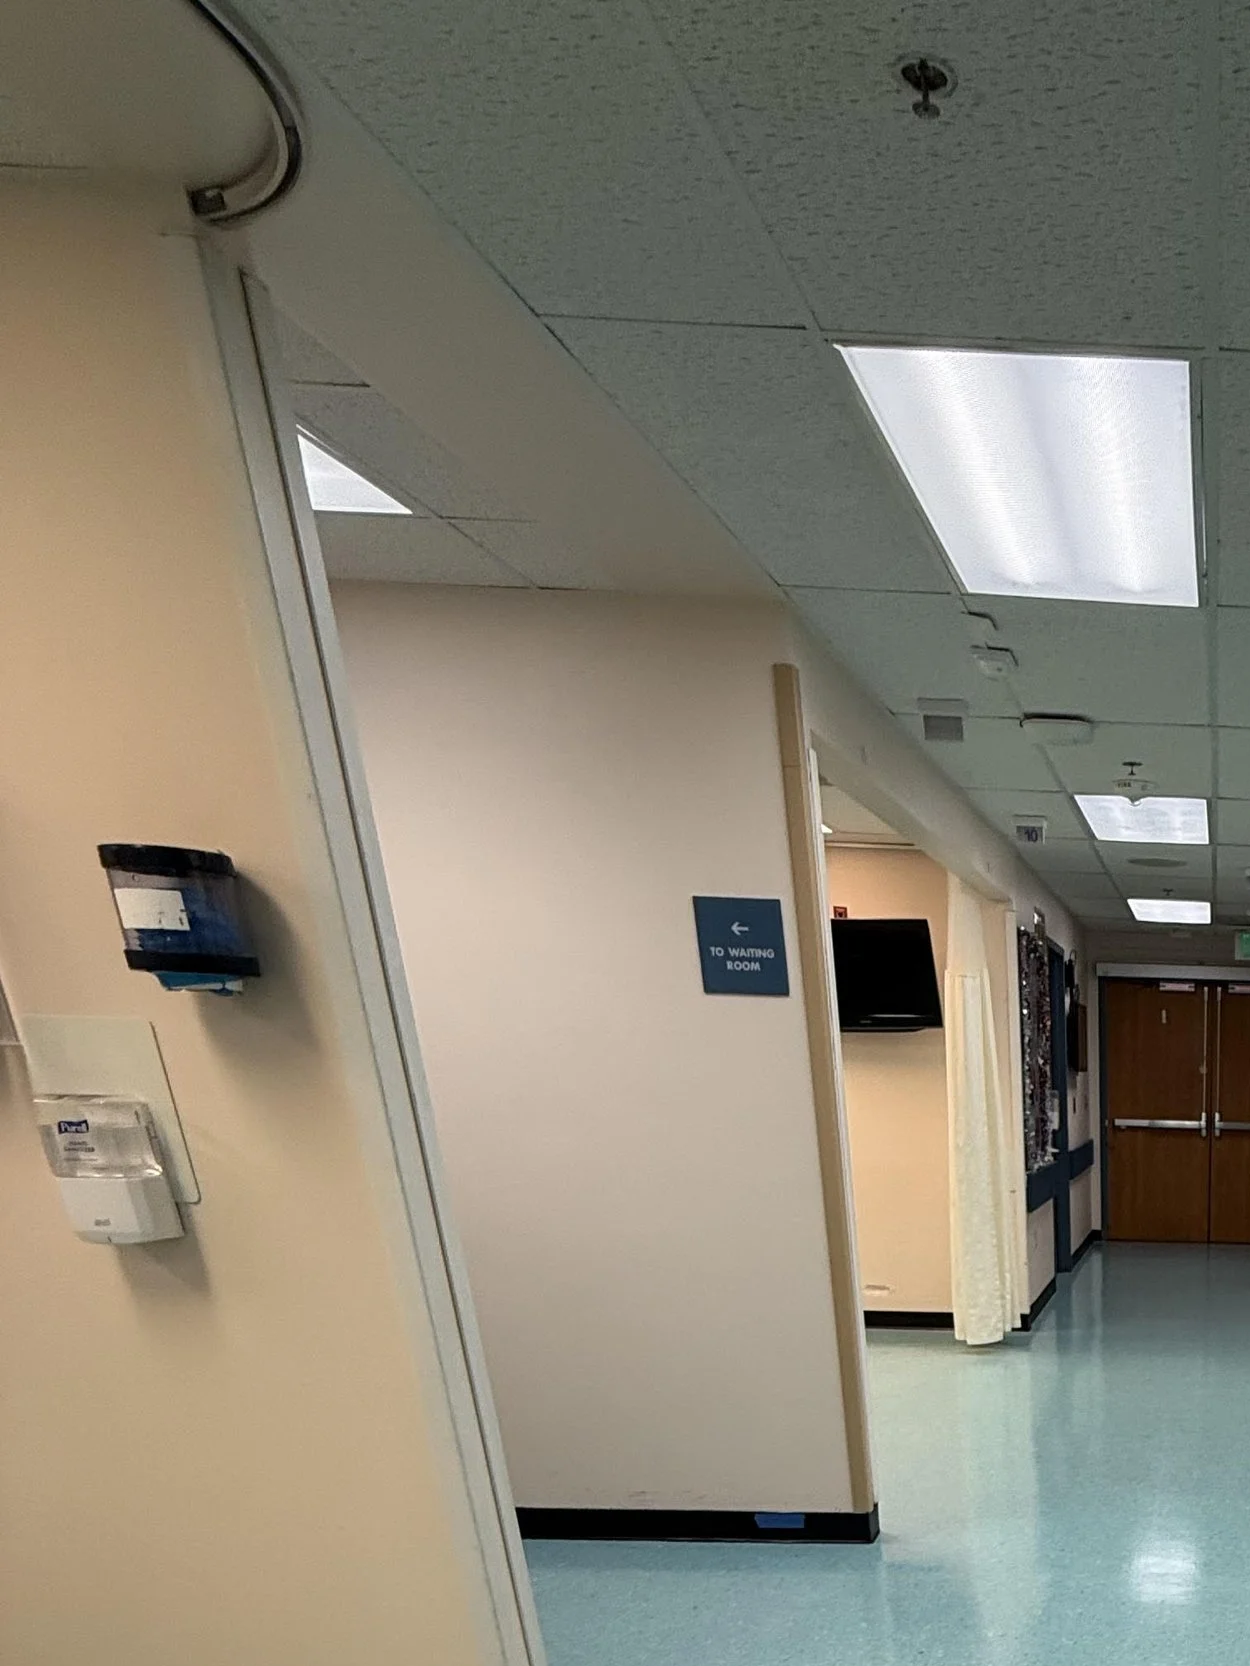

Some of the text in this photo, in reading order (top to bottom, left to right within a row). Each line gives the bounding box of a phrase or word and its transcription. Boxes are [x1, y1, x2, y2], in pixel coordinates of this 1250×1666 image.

[1024, 829, 1038, 843] 10
[709, 946, 775, 959] TO WAITING
[726, 960, 761, 971] ROOM
